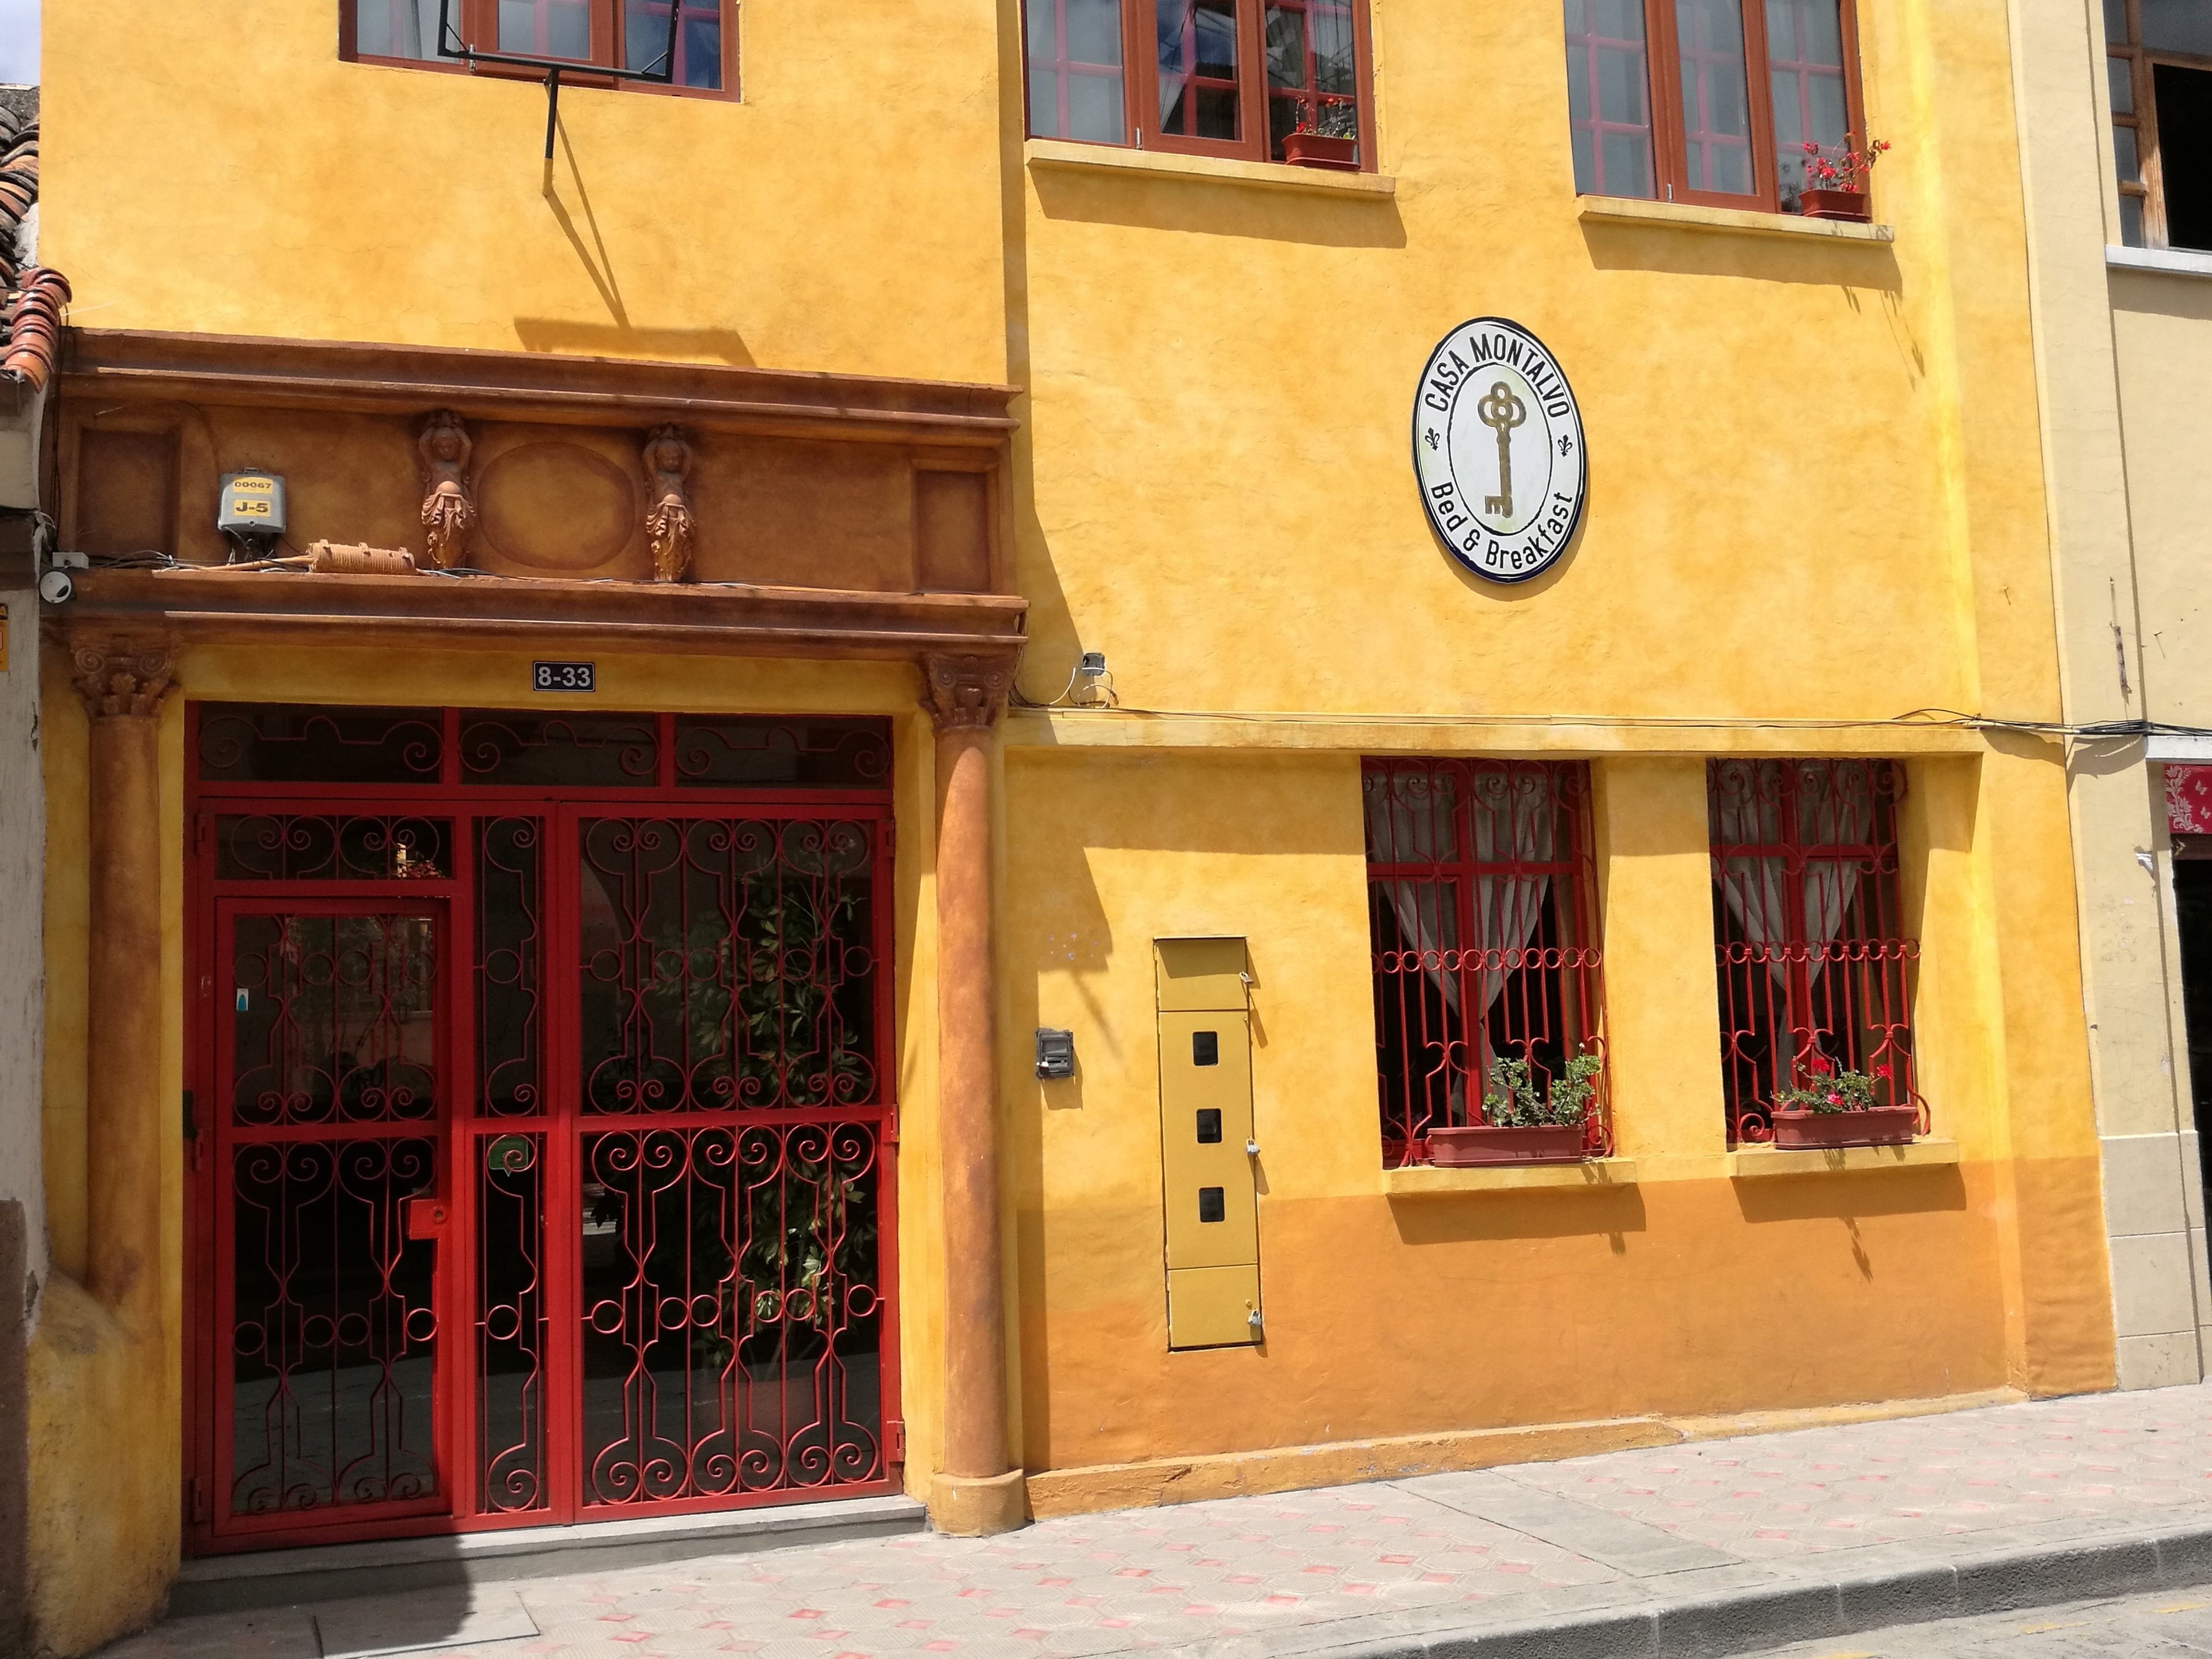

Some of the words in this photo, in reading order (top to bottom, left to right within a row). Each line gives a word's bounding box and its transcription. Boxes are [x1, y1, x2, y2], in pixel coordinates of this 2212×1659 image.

[1426, 350, 1469, 412] CASA
[1469, 333, 1570, 418] MONTALVO
[236, 502, 268, 513] J-5
[1431, 482, 1468, 533] Bed
[1463, 528, 1480, 551] &
[1485, 491, 1573, 569] Breakfast
[538, 666, 590, 687] 8-33
